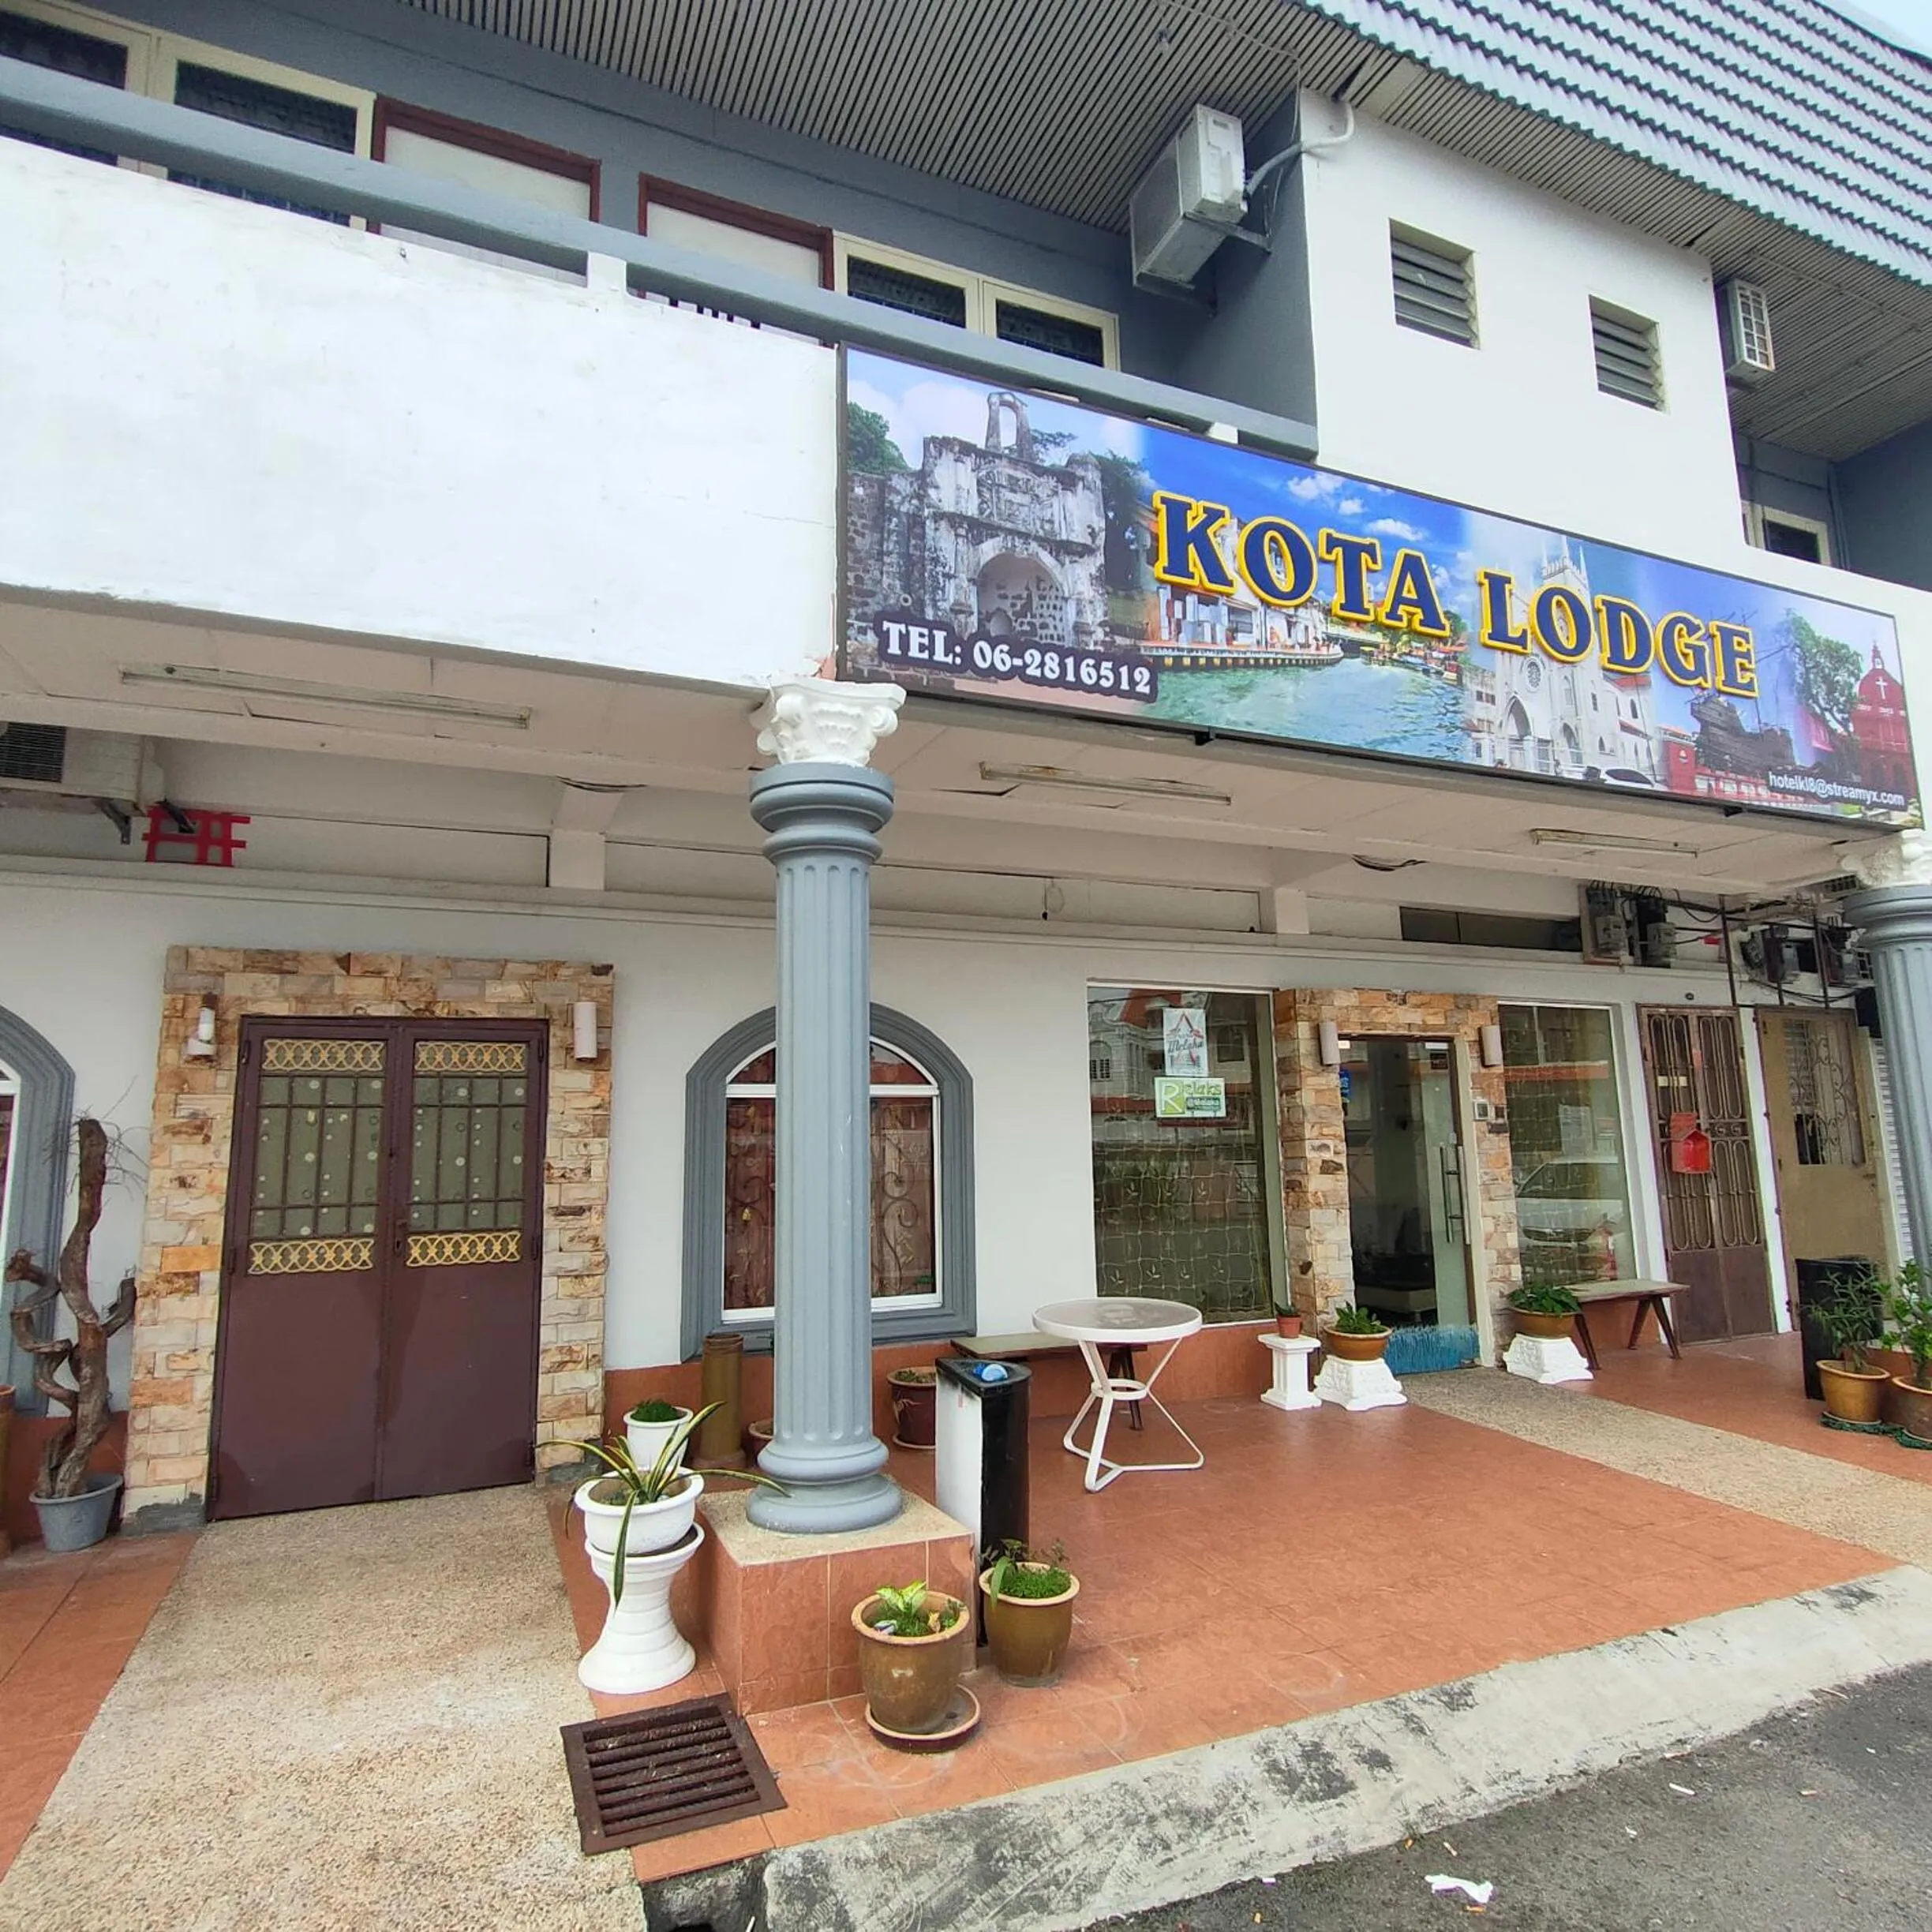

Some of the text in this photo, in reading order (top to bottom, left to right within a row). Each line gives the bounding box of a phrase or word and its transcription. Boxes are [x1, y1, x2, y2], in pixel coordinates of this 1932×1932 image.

[882, 620, 1151, 695] TEL: 06-2816512
[1153, 490, 1759, 699] KOTA LODGE
